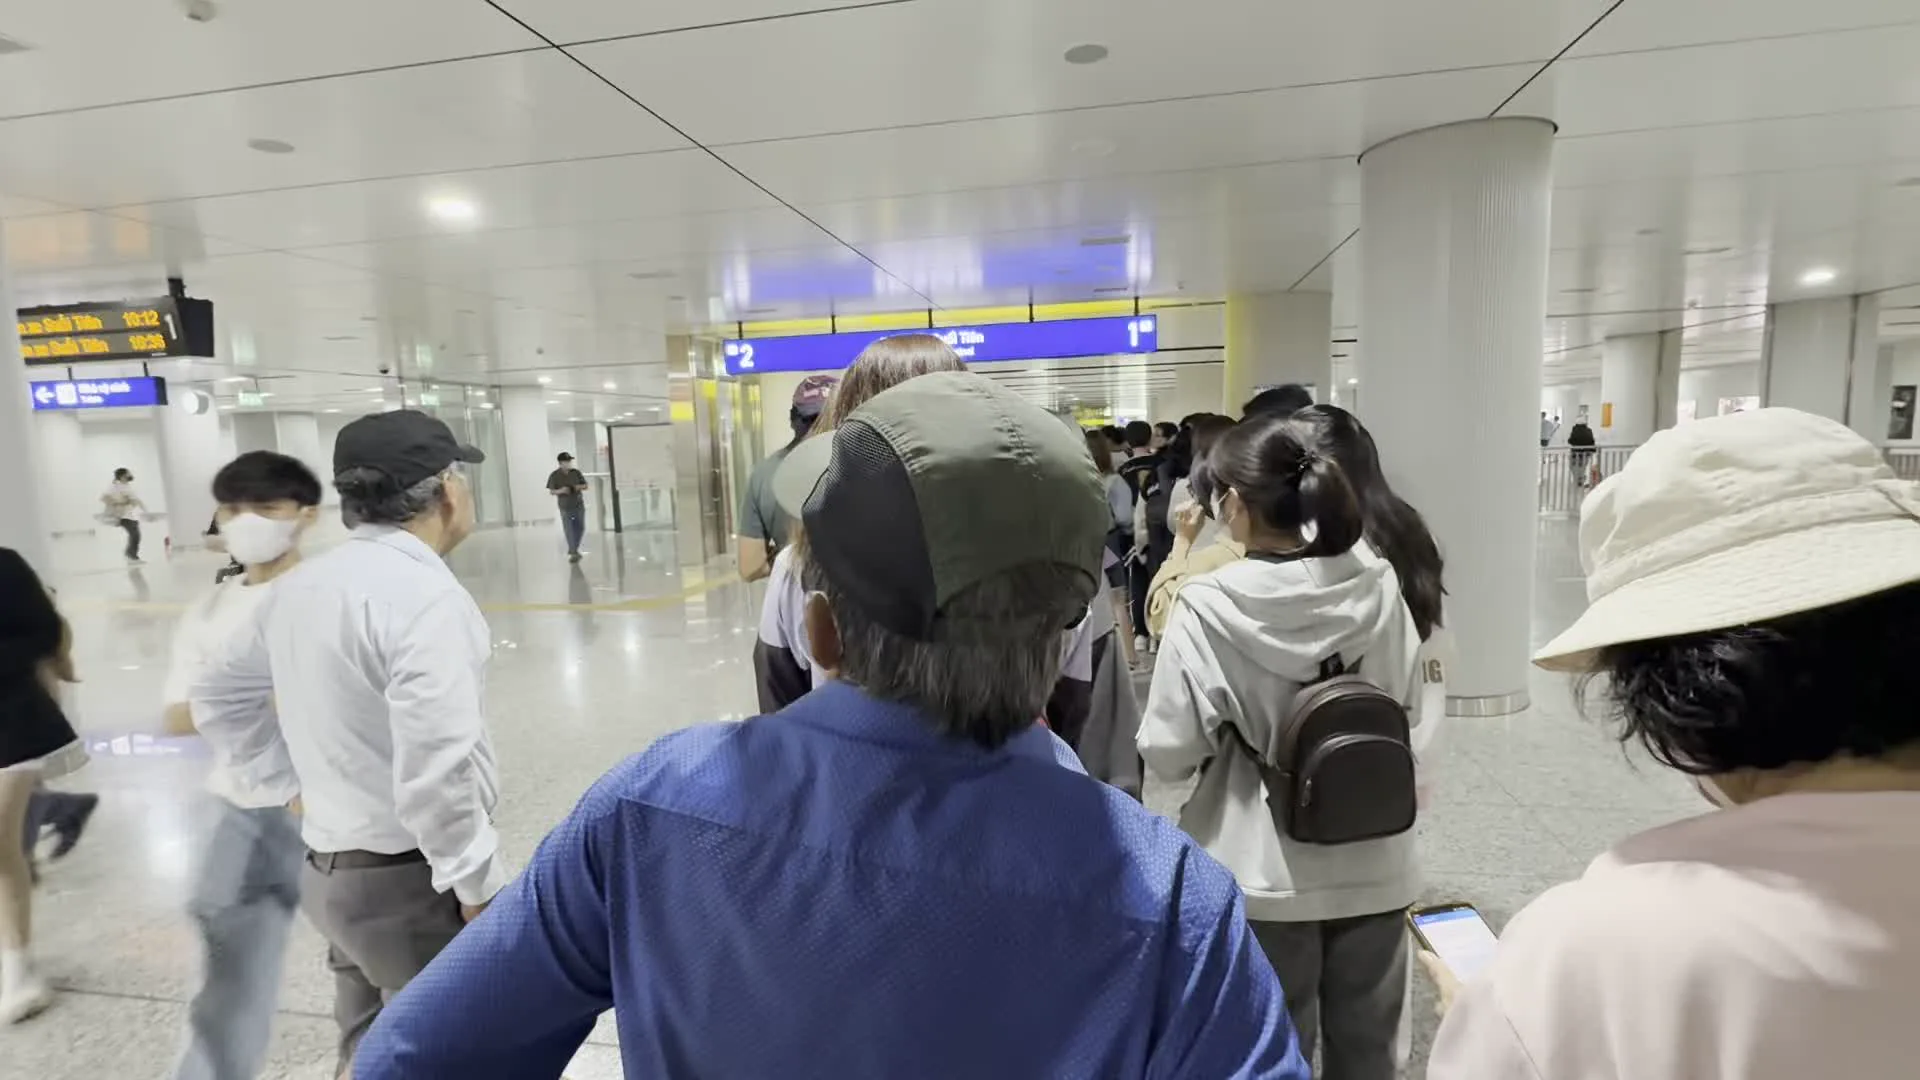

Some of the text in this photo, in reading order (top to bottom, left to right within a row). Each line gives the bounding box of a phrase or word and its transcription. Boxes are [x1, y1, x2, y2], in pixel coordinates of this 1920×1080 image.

[122, 310, 160, 328] 10:12
[164, 313, 177, 340] 1
[1128, 321, 1138, 347] 1
[740, 343, 754, 368] 2
